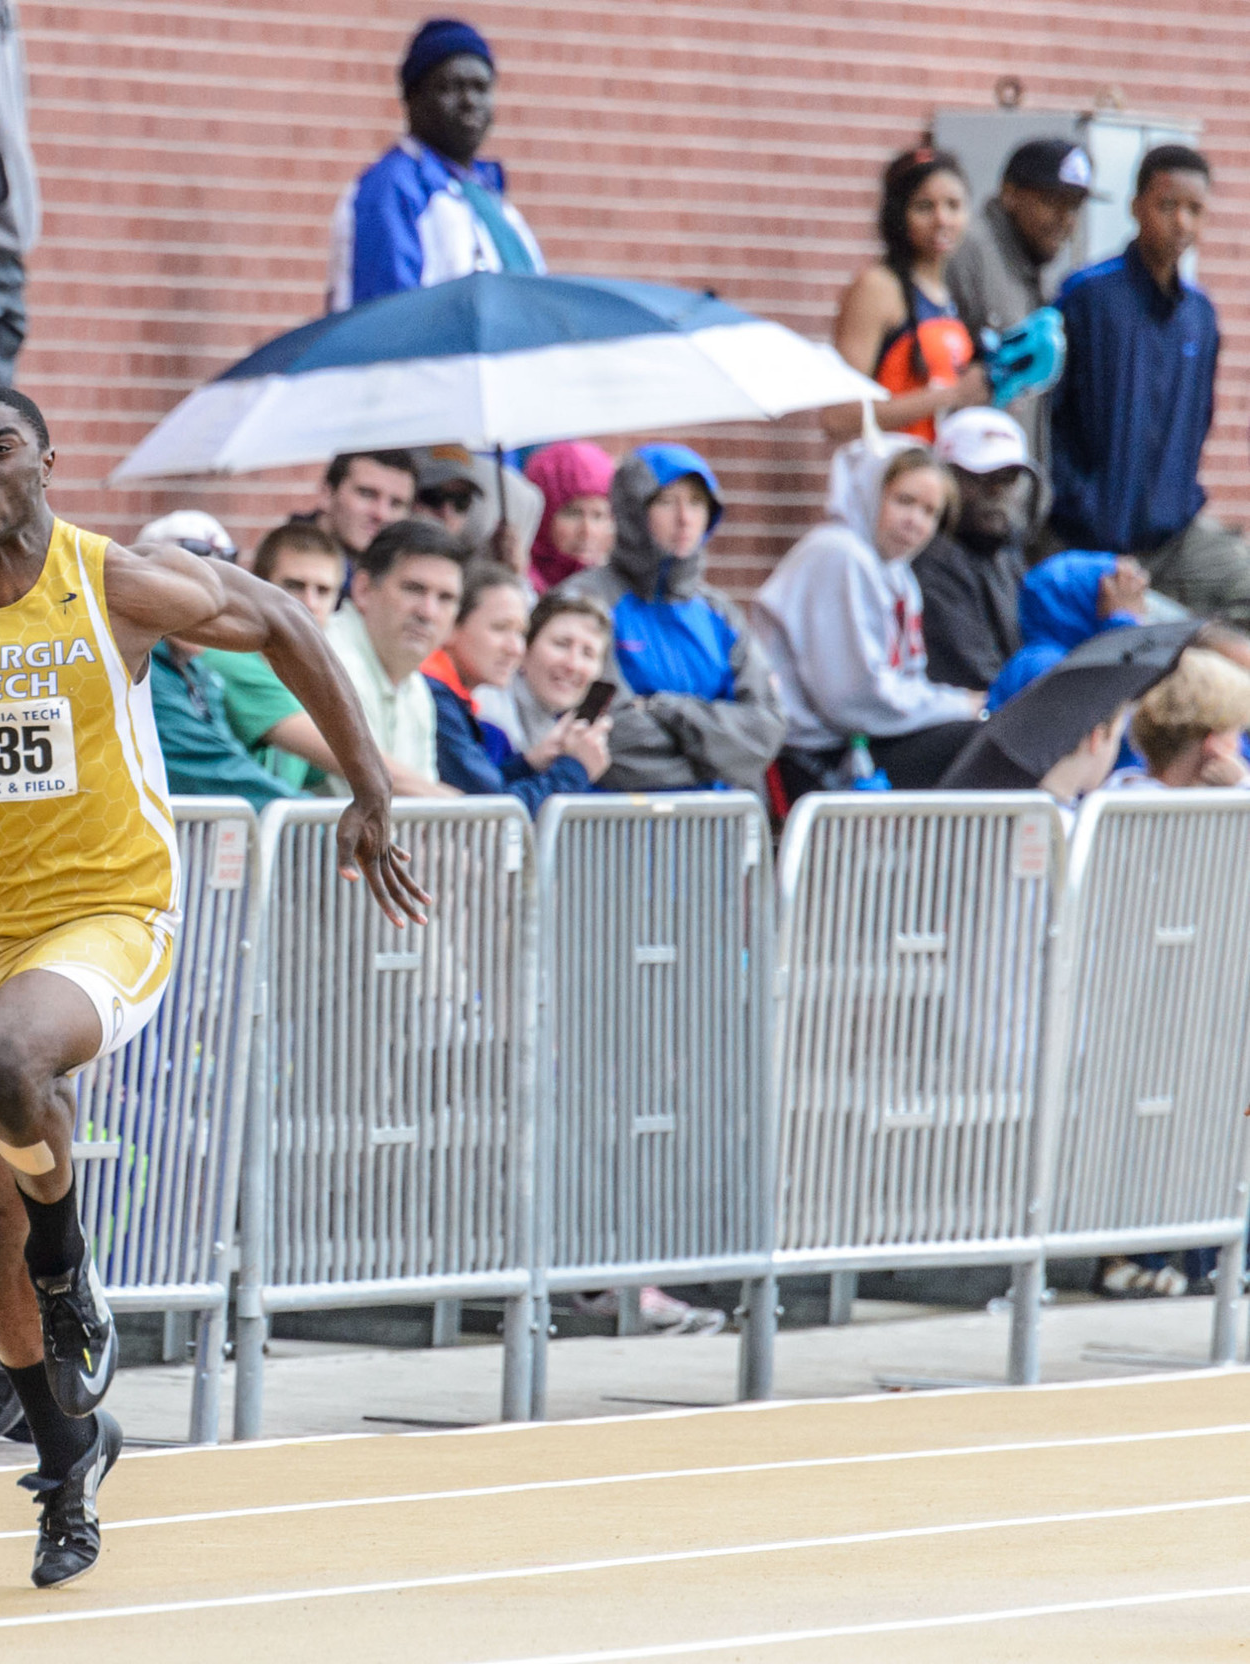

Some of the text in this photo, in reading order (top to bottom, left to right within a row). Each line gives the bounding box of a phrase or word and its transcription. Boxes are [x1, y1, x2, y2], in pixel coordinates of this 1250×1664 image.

[22, 708, 61, 722] TECH
[8, 782, 19, 793] &
[25, 779, 66, 793] FIELD
